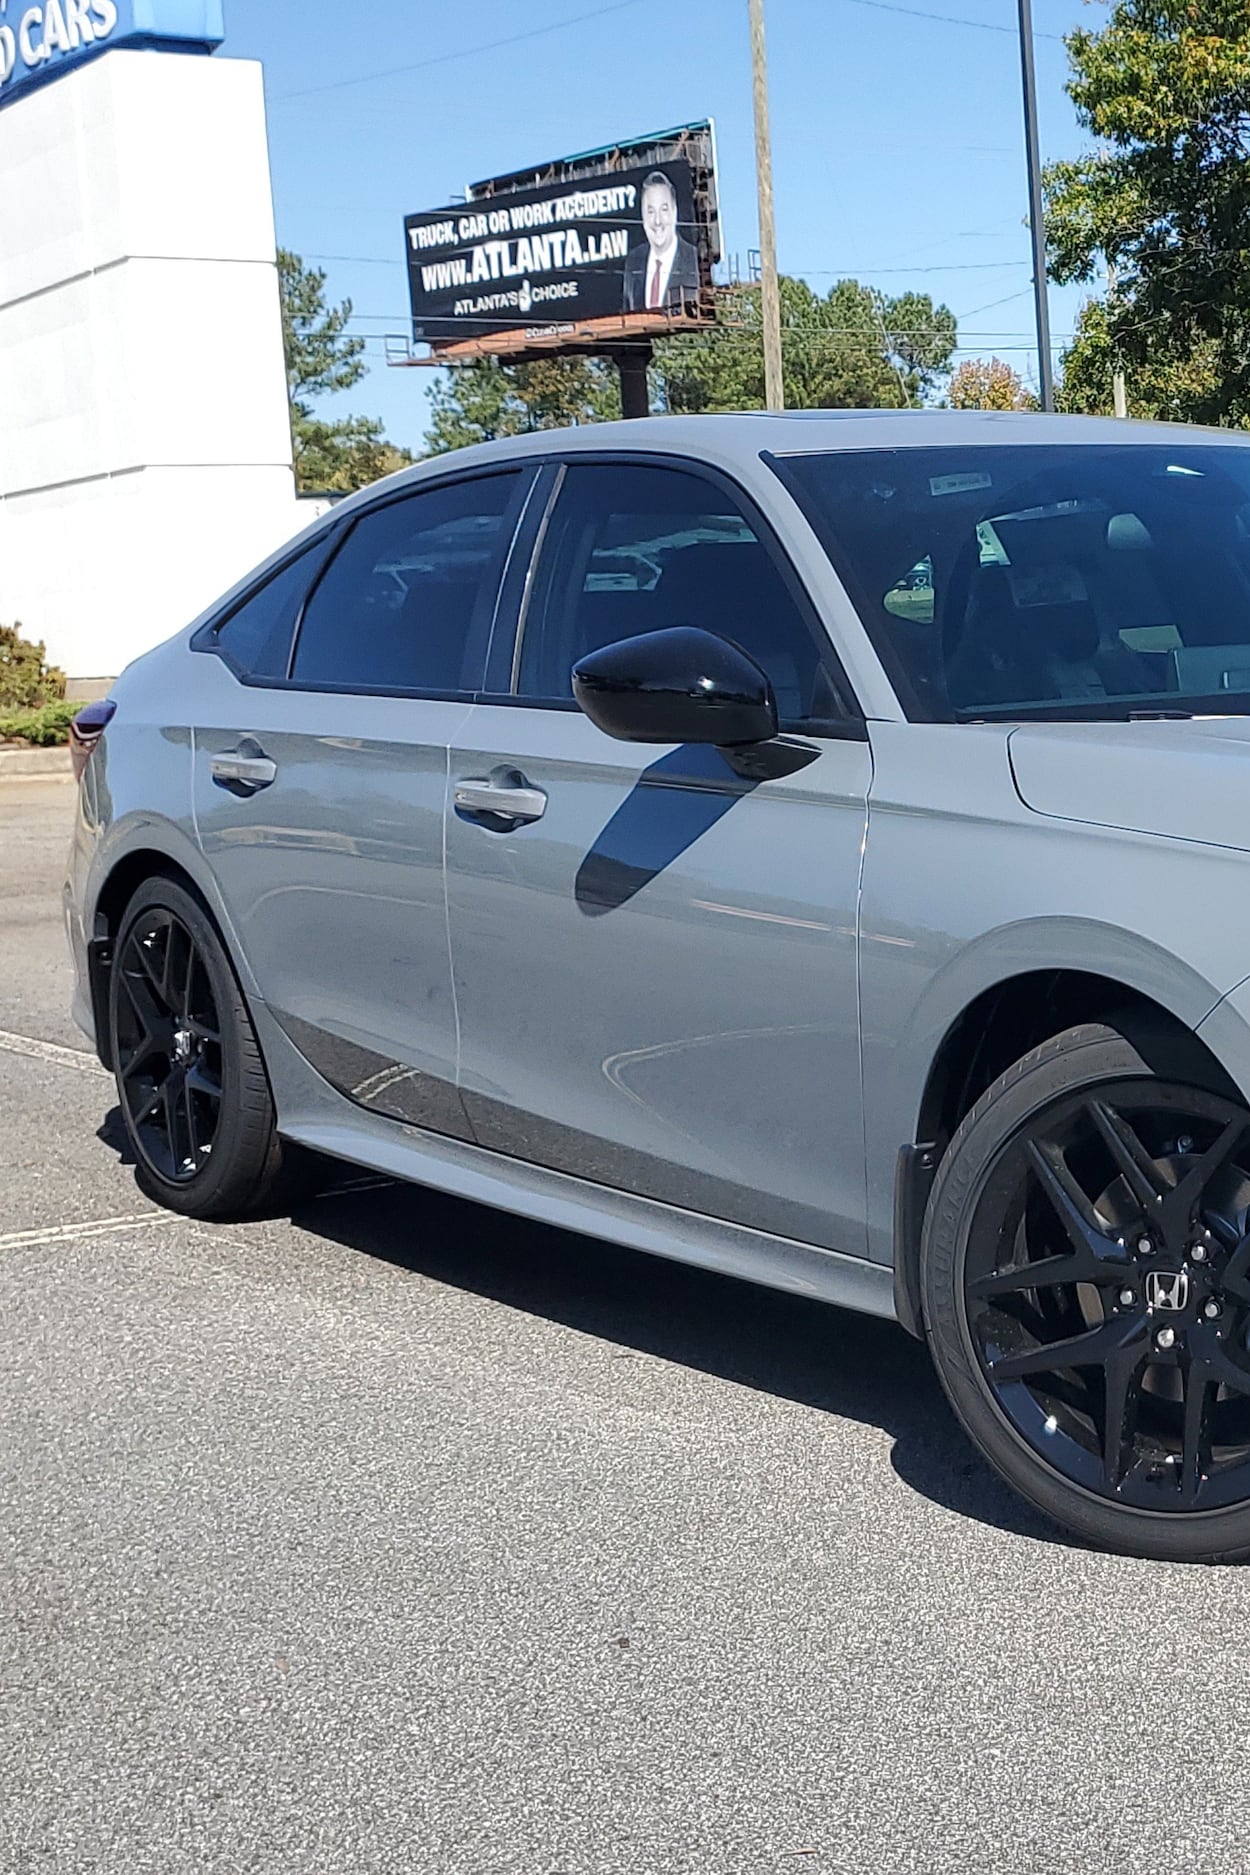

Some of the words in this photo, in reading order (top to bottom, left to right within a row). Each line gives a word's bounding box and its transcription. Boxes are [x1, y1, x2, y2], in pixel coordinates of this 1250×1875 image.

[20, 0, 117, 66] CARS
[409, 220, 458, 250] TRUCK,
[458, 214, 488, 241] CAR
[488, 210, 510, 235] OR
[511, 201, 554, 228] WORK
[554, 185, 637, 222] ACCIDENT?
[453, 290, 518, 317] ATLANTA'S
[531, 280, 579, 304] CHOICE
